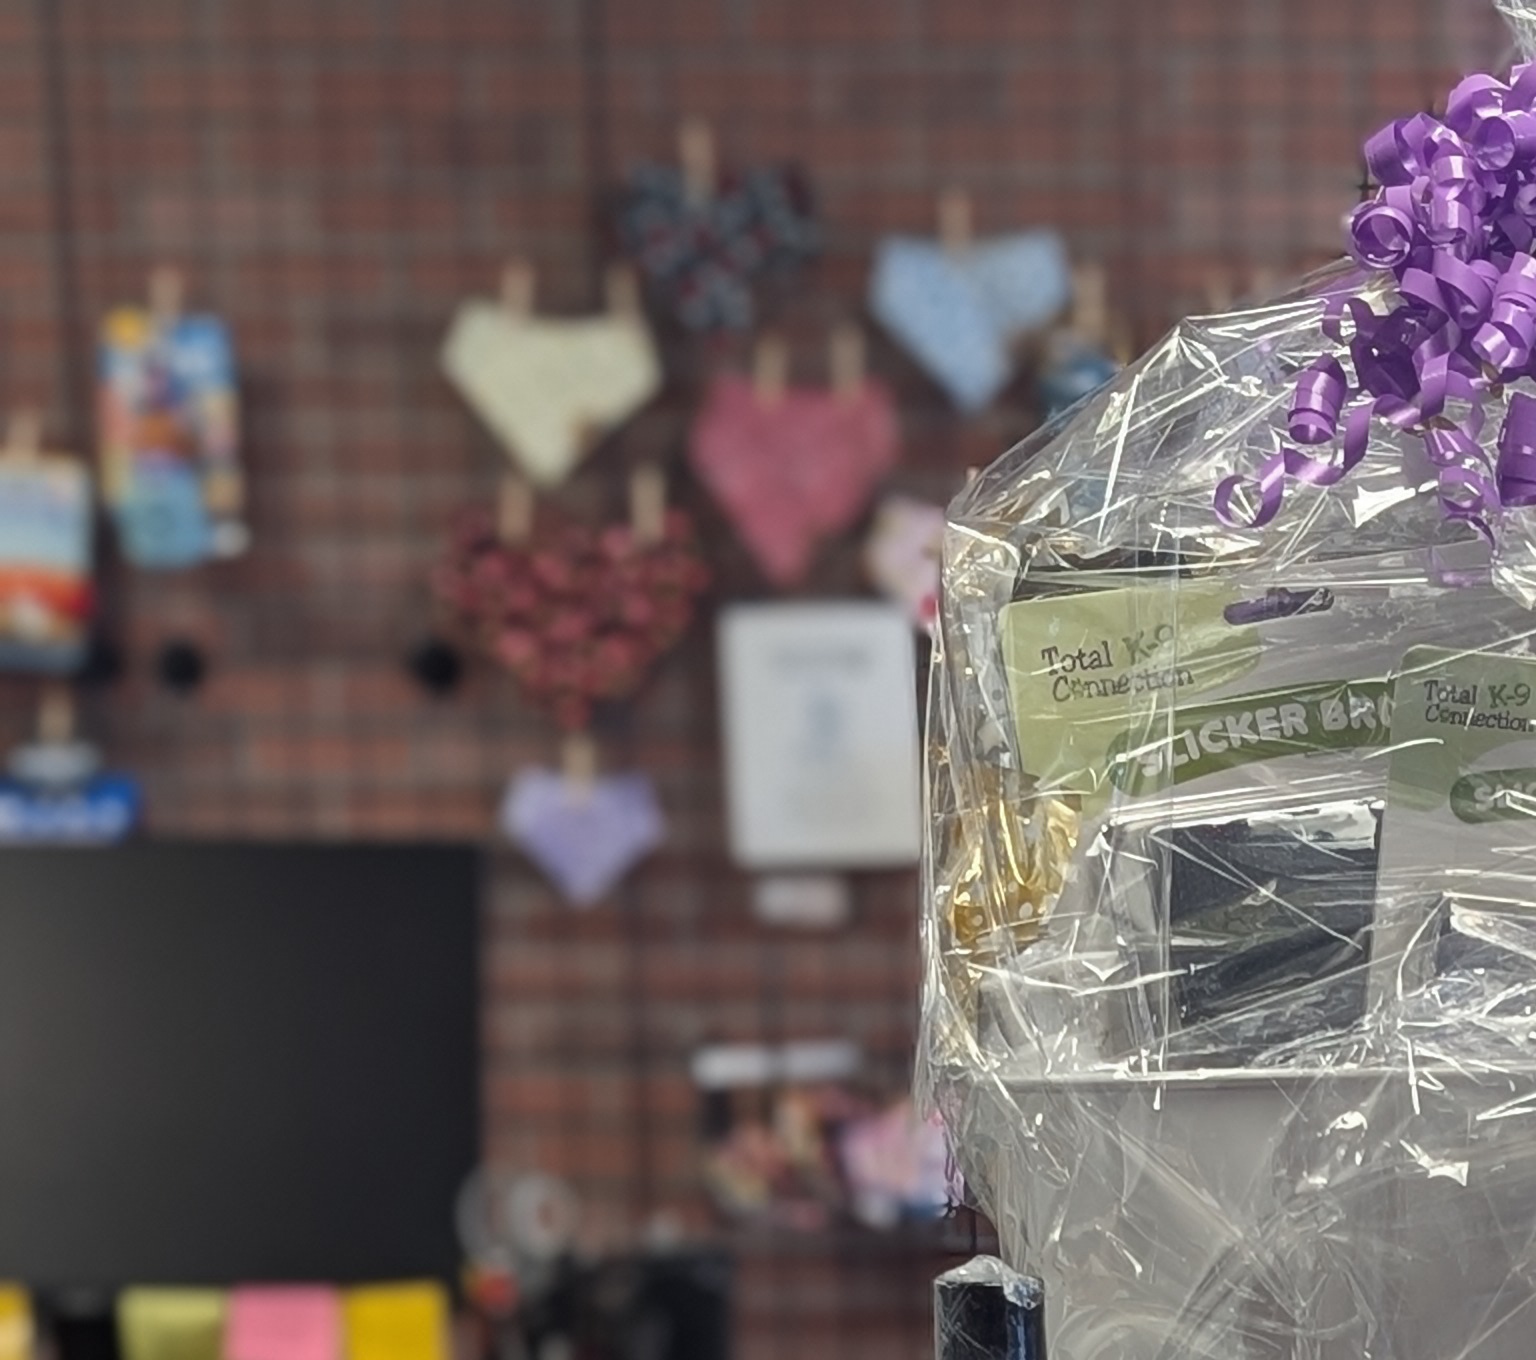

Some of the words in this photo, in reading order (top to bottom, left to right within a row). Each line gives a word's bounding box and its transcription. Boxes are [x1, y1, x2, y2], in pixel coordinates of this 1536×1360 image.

[1041, 641, 1113, 676] Total
[1424, 681, 1477, 705] Total
[1488, 683, 1531, 710] K-9
